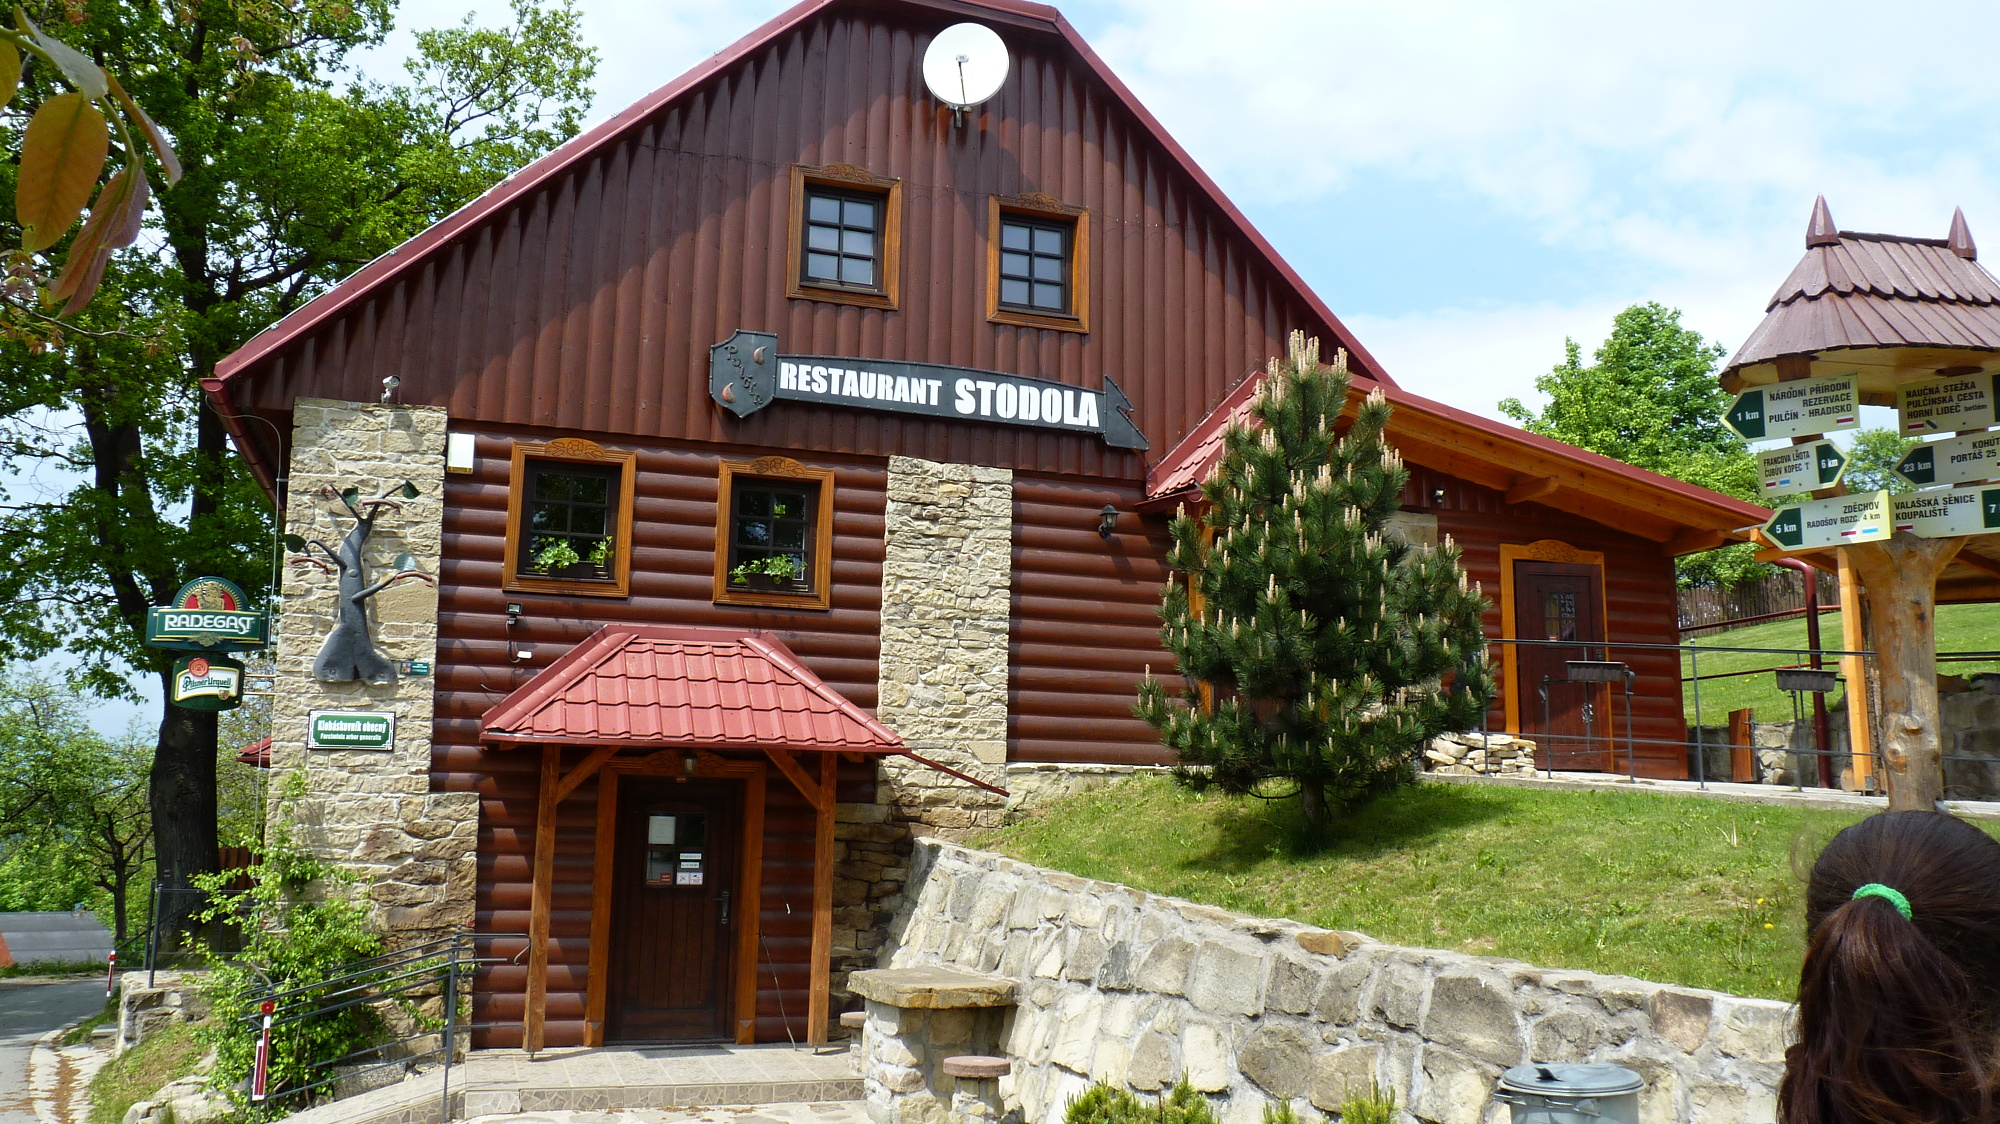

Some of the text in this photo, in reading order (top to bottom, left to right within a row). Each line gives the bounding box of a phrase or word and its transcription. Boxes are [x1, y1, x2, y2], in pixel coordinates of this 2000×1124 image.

[779, 362, 1100, 428] RESTAURANT STODOLA
[1769, 379, 1851, 401] NÁRODNÍ PŘÍRODNÍ
[1906, 380, 1977, 399] NAUČNÁ STEŽKA
[1802, 392, 1851, 407] REZERVACE
[1906, 391, 1985, 409] PULČÍNSKÁ CESTA
[1737, 410, 1760, 421] 1 km
[1769, 409, 1799, 423] PULČÍN
[1808, 404, 1852, 417] HRADISKO
[1907, 406, 1933, 419] HORNÍ
[1936, 403, 1961, 416] LIDEČ
[1763, 451, 1810, 467] FRANCOVA LHOTA
[1821, 458, 1839, 469] 6 km
[1950, 449, 1997, 463] PORTÁŠ 25
[1784, 463, 1802, 474] KOPEC
[1903, 461, 1932, 473] 23 km
[1843, 501, 1880, 514] ZDĚCHOV
[1894, 496, 1940, 510] VALAŠSKÁ
[1989, 504, 1997, 514] 7
[1895, 506, 1949, 521] KOUPALIŠTĚ
[1776, 523, 1797, 534] 5 km
[1806, 517, 1838, 529] RADOŠOV
[1840, 515, 1860, 524] ROZC.
[164, 614, 255, 634] RADEGAST
[182, 675, 232, 692] Pilsner Urquell
